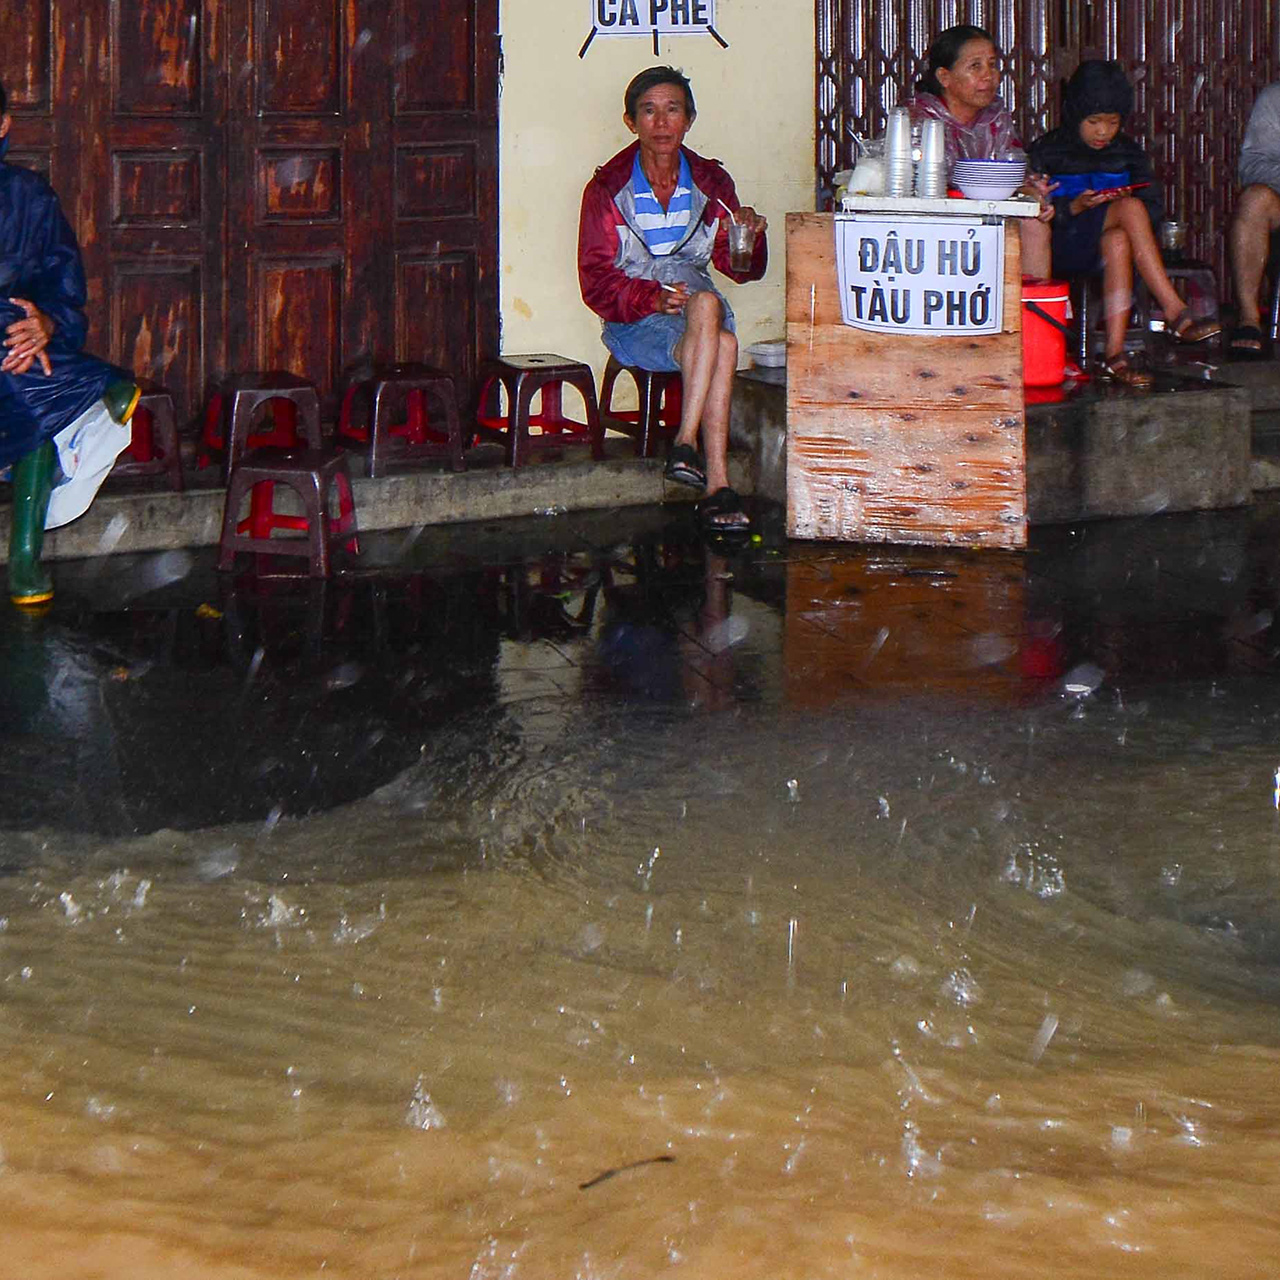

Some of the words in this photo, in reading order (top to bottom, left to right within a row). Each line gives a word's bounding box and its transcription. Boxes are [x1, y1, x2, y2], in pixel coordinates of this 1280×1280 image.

[858, 230, 925, 281] ĐẬU
[937, 228, 981, 277] HỦ
[850, 280, 911, 325] TÀU
[923, 283, 991, 326] PHỚ
